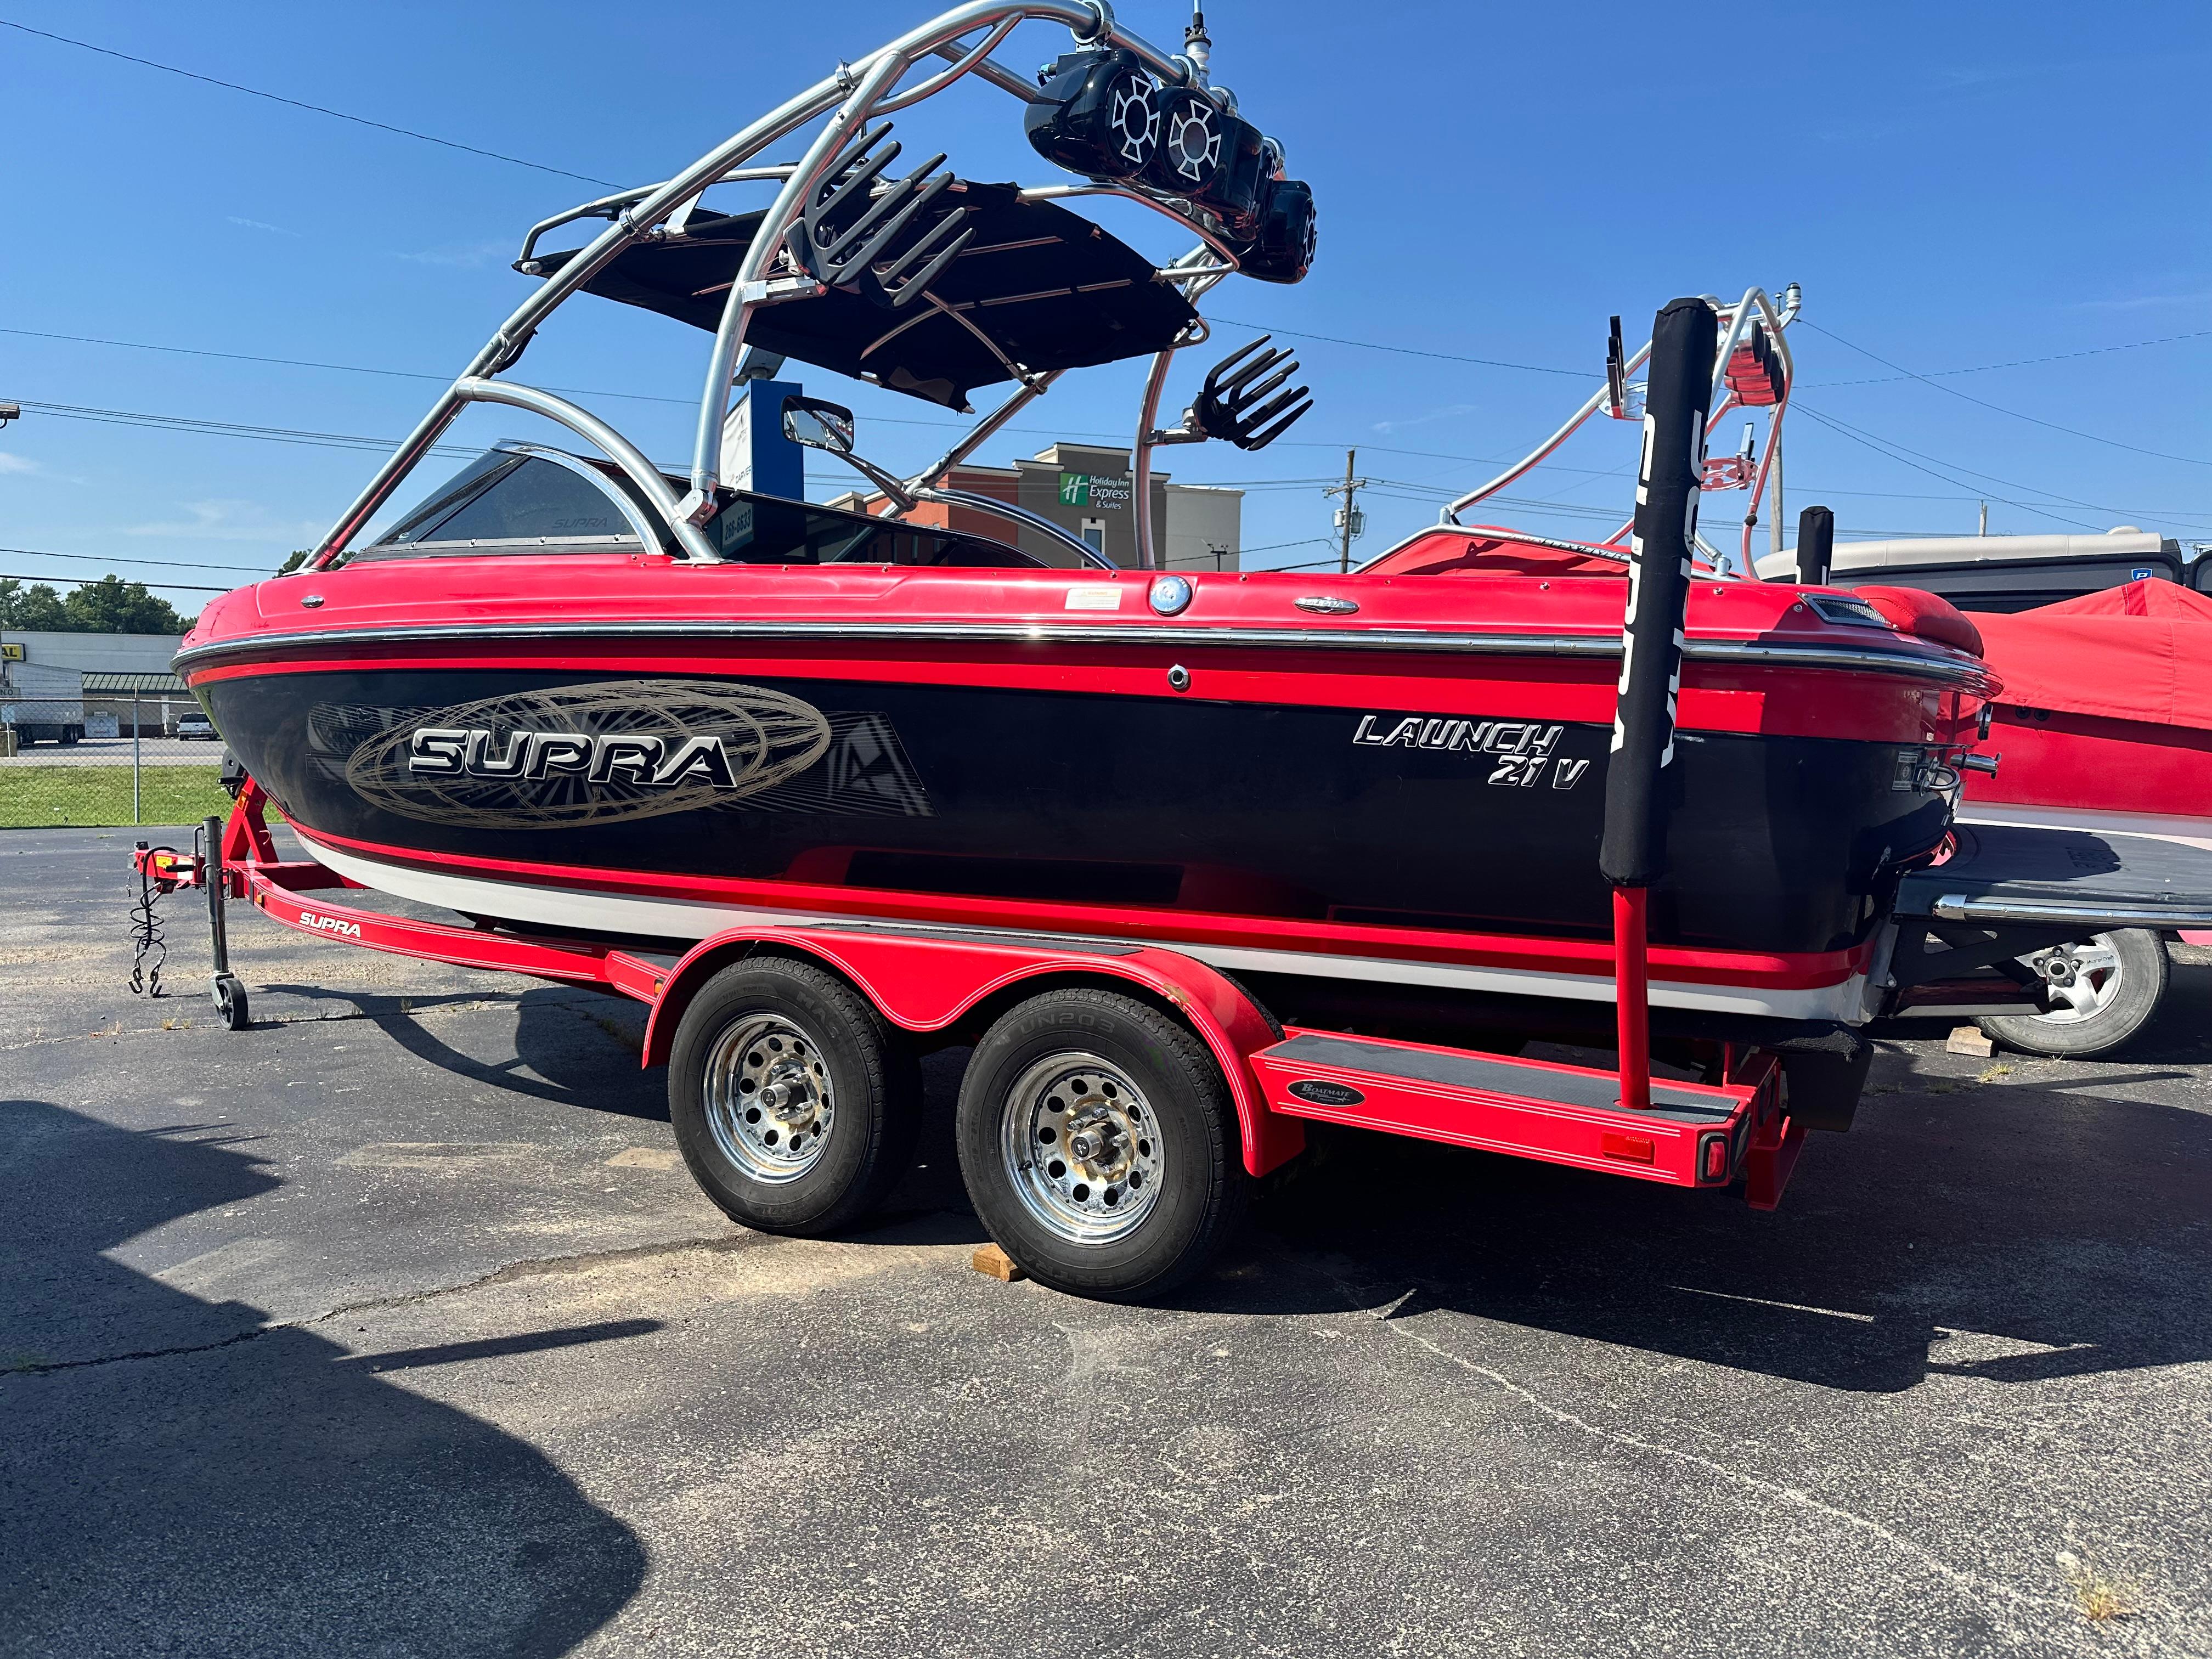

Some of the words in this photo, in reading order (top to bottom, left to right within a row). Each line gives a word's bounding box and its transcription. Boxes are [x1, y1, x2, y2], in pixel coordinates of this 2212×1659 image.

[1090, 475, 1118, 488] Holiday
[1118, 478, 1130, 487] Inn
[1090, 485, 1129, 500] Express
[1102, 501, 1121, 510] Suites
[552, 517, 608, 529] SUPRA
[2, 647, 18, 657] AL
[1352, 715, 1565, 757] LAUNCH
[408, 728, 737, 788] SUPRA
[1487, 755, 1548, 787] 21
[1552, 758, 1590, 790] V
[298, 911, 362, 938] SUPRA
[1019, 1012, 1115, 1035] UN203
